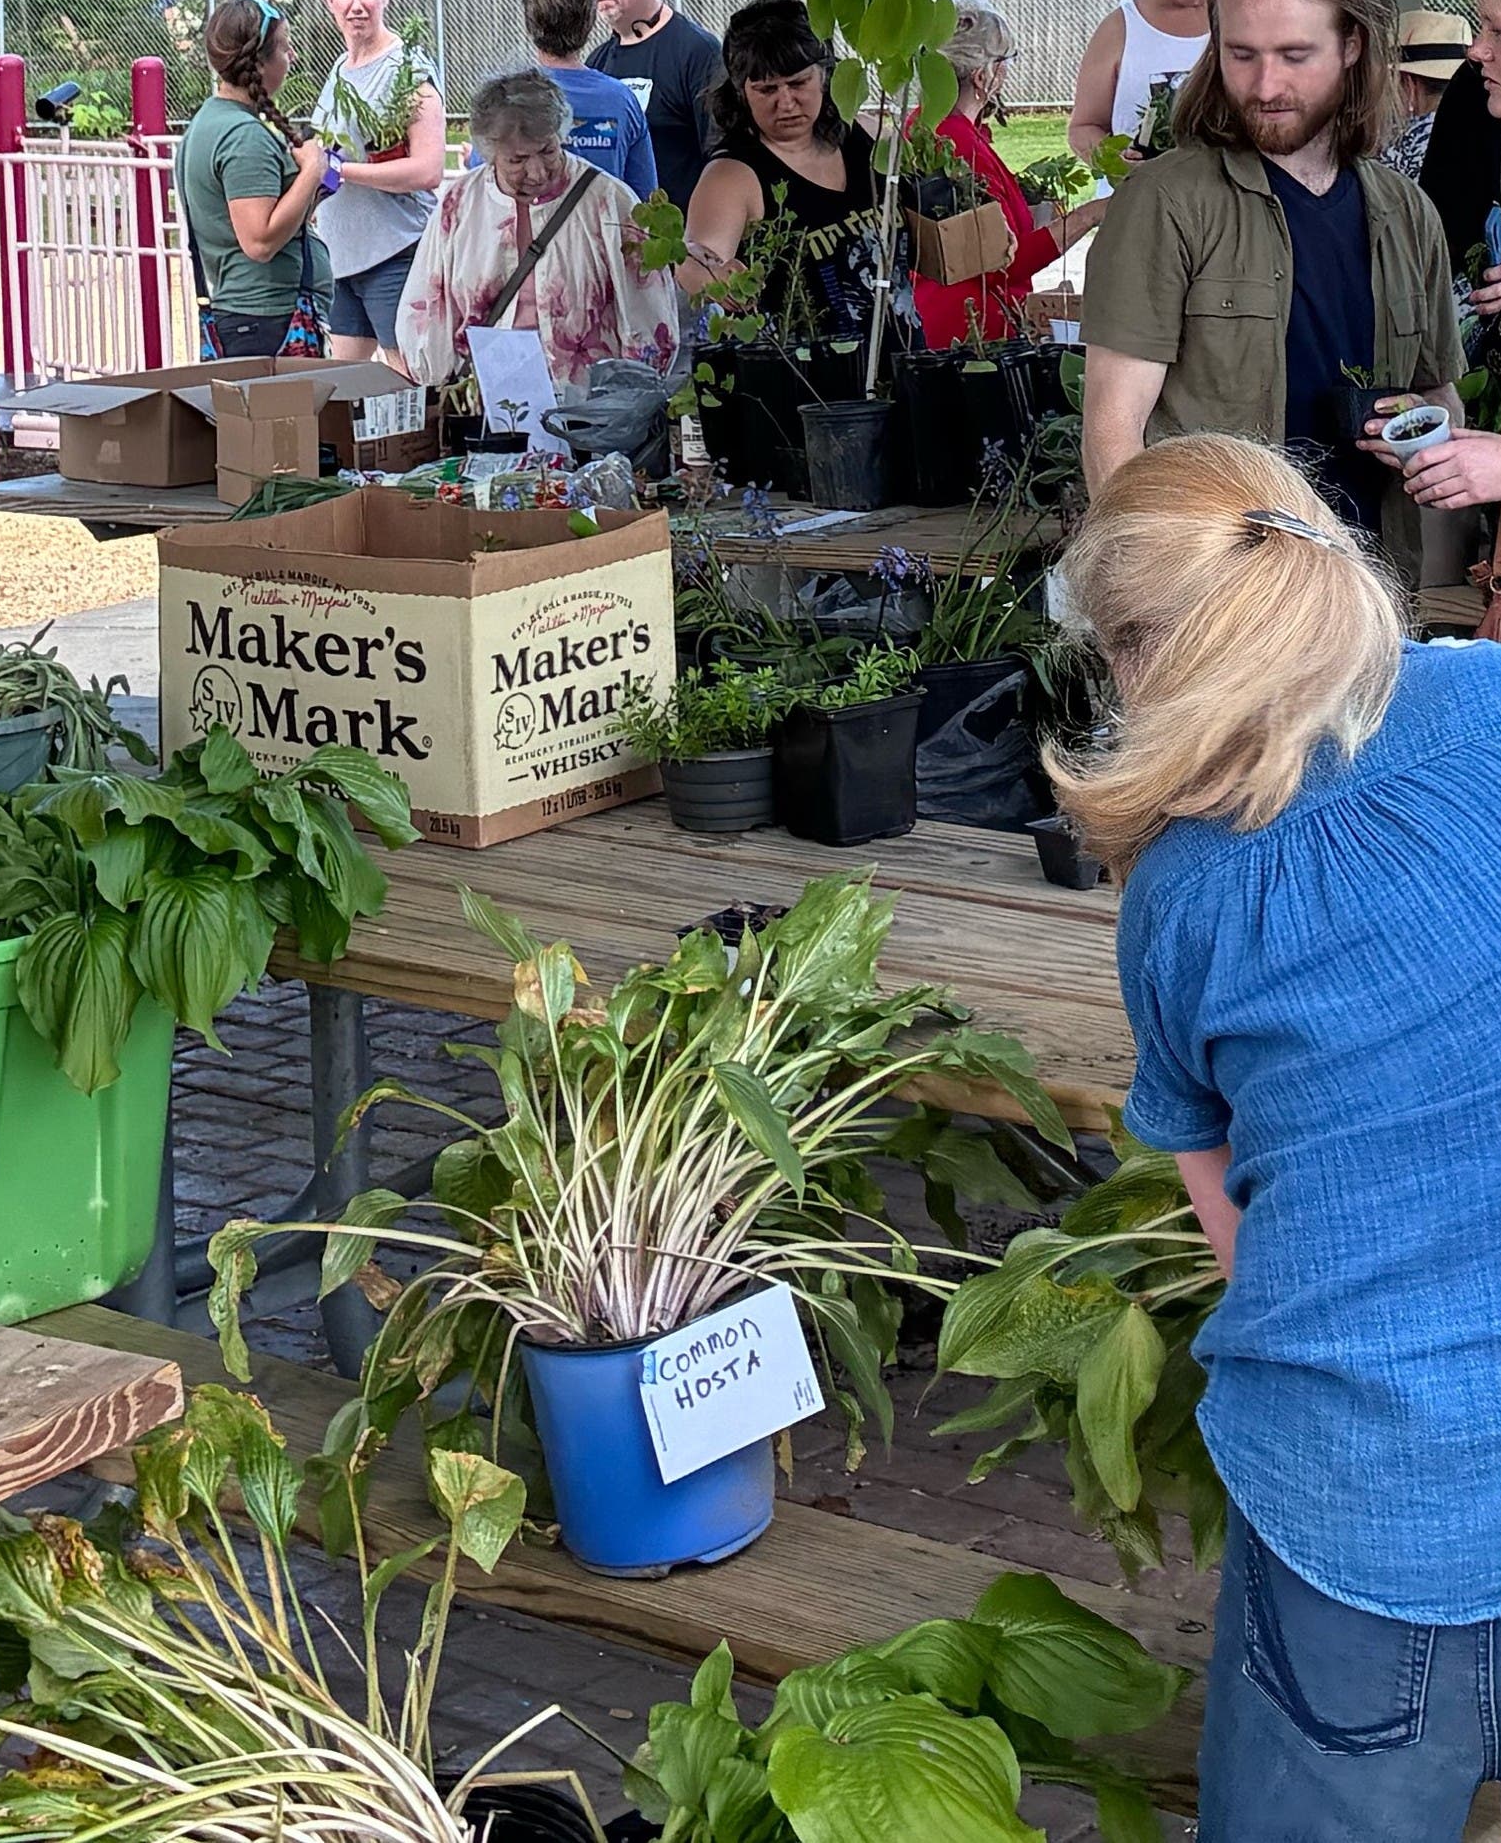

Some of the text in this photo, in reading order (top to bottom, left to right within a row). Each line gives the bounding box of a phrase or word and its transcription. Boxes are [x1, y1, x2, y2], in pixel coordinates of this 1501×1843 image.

[185, 600, 427, 683] Maker's
[490, 619, 651, 695] Maker's
[202, 678, 214, 701] S
[216, 699, 236, 724] IV
[246, 682, 429, 760] Mark
[504, 705, 515, 723] S
[515, 714, 532, 735] IV
[674, 1349, 761, 1409] HOSTA
